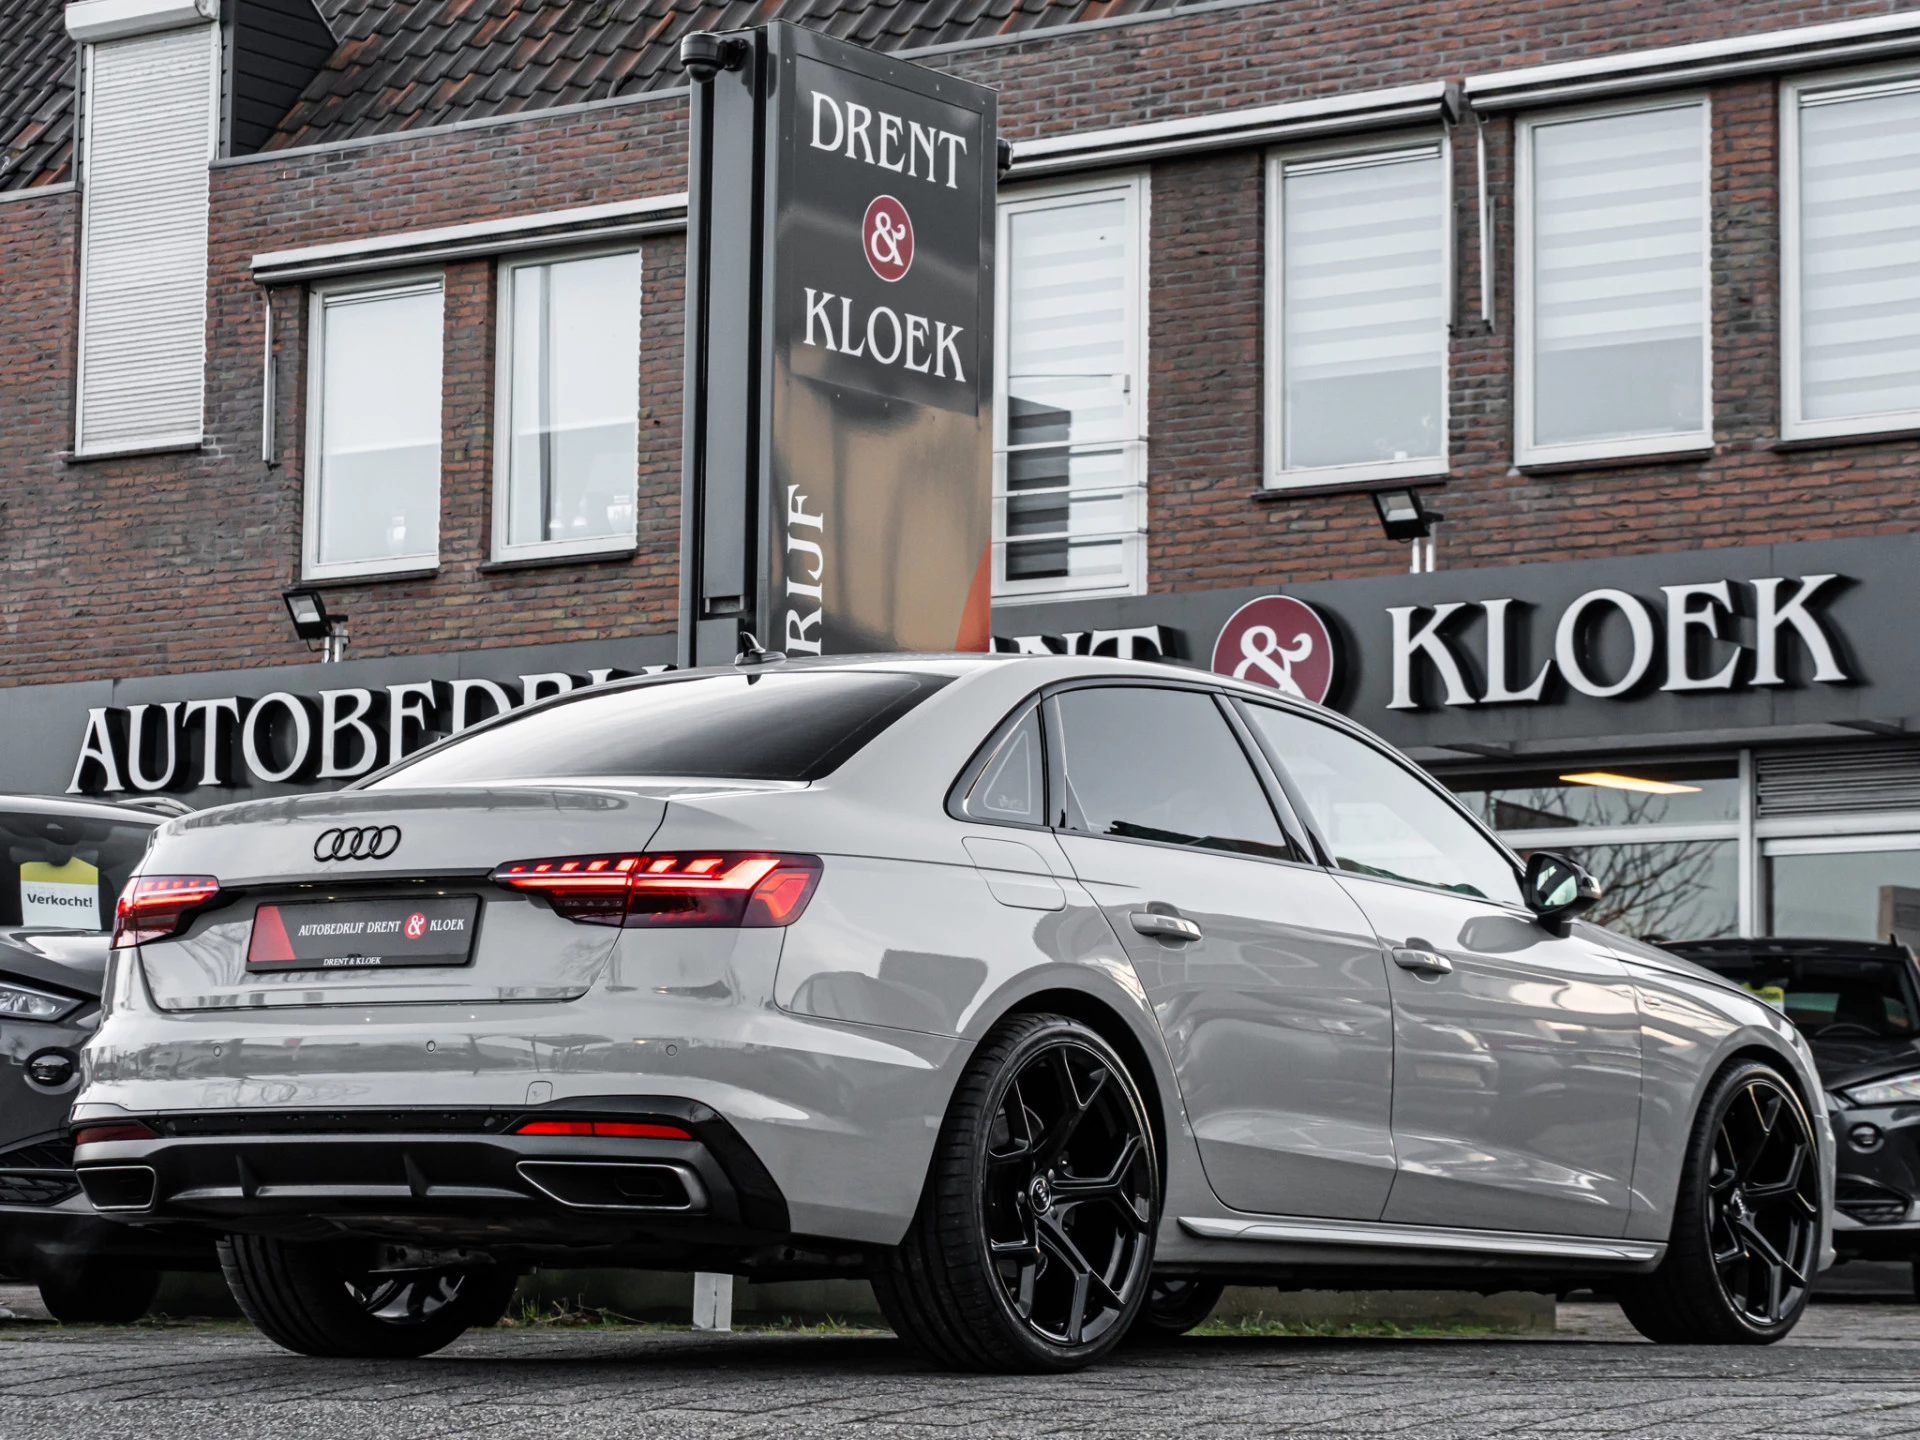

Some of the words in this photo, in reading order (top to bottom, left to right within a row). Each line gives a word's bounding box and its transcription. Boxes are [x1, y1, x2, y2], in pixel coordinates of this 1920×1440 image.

[810, 90, 968, 190] DRENT
[871, 211, 906, 266] &
[803, 287, 967, 383] KLOEK
[1385, 574, 1848, 710] KLOEK
[26, 893, 93, 908] Verkocht!
[298, 922, 365, 936] AUTOBEDRIJF
[366, 920, 401, 934] DRENT
[407, 915, 425, 936] &
[429, 919, 465, 931] KLOEK
[323, 957, 349, 966] DRENT
[348, 957, 355, 965] &
[355, 957, 382, 965] KLOEK
